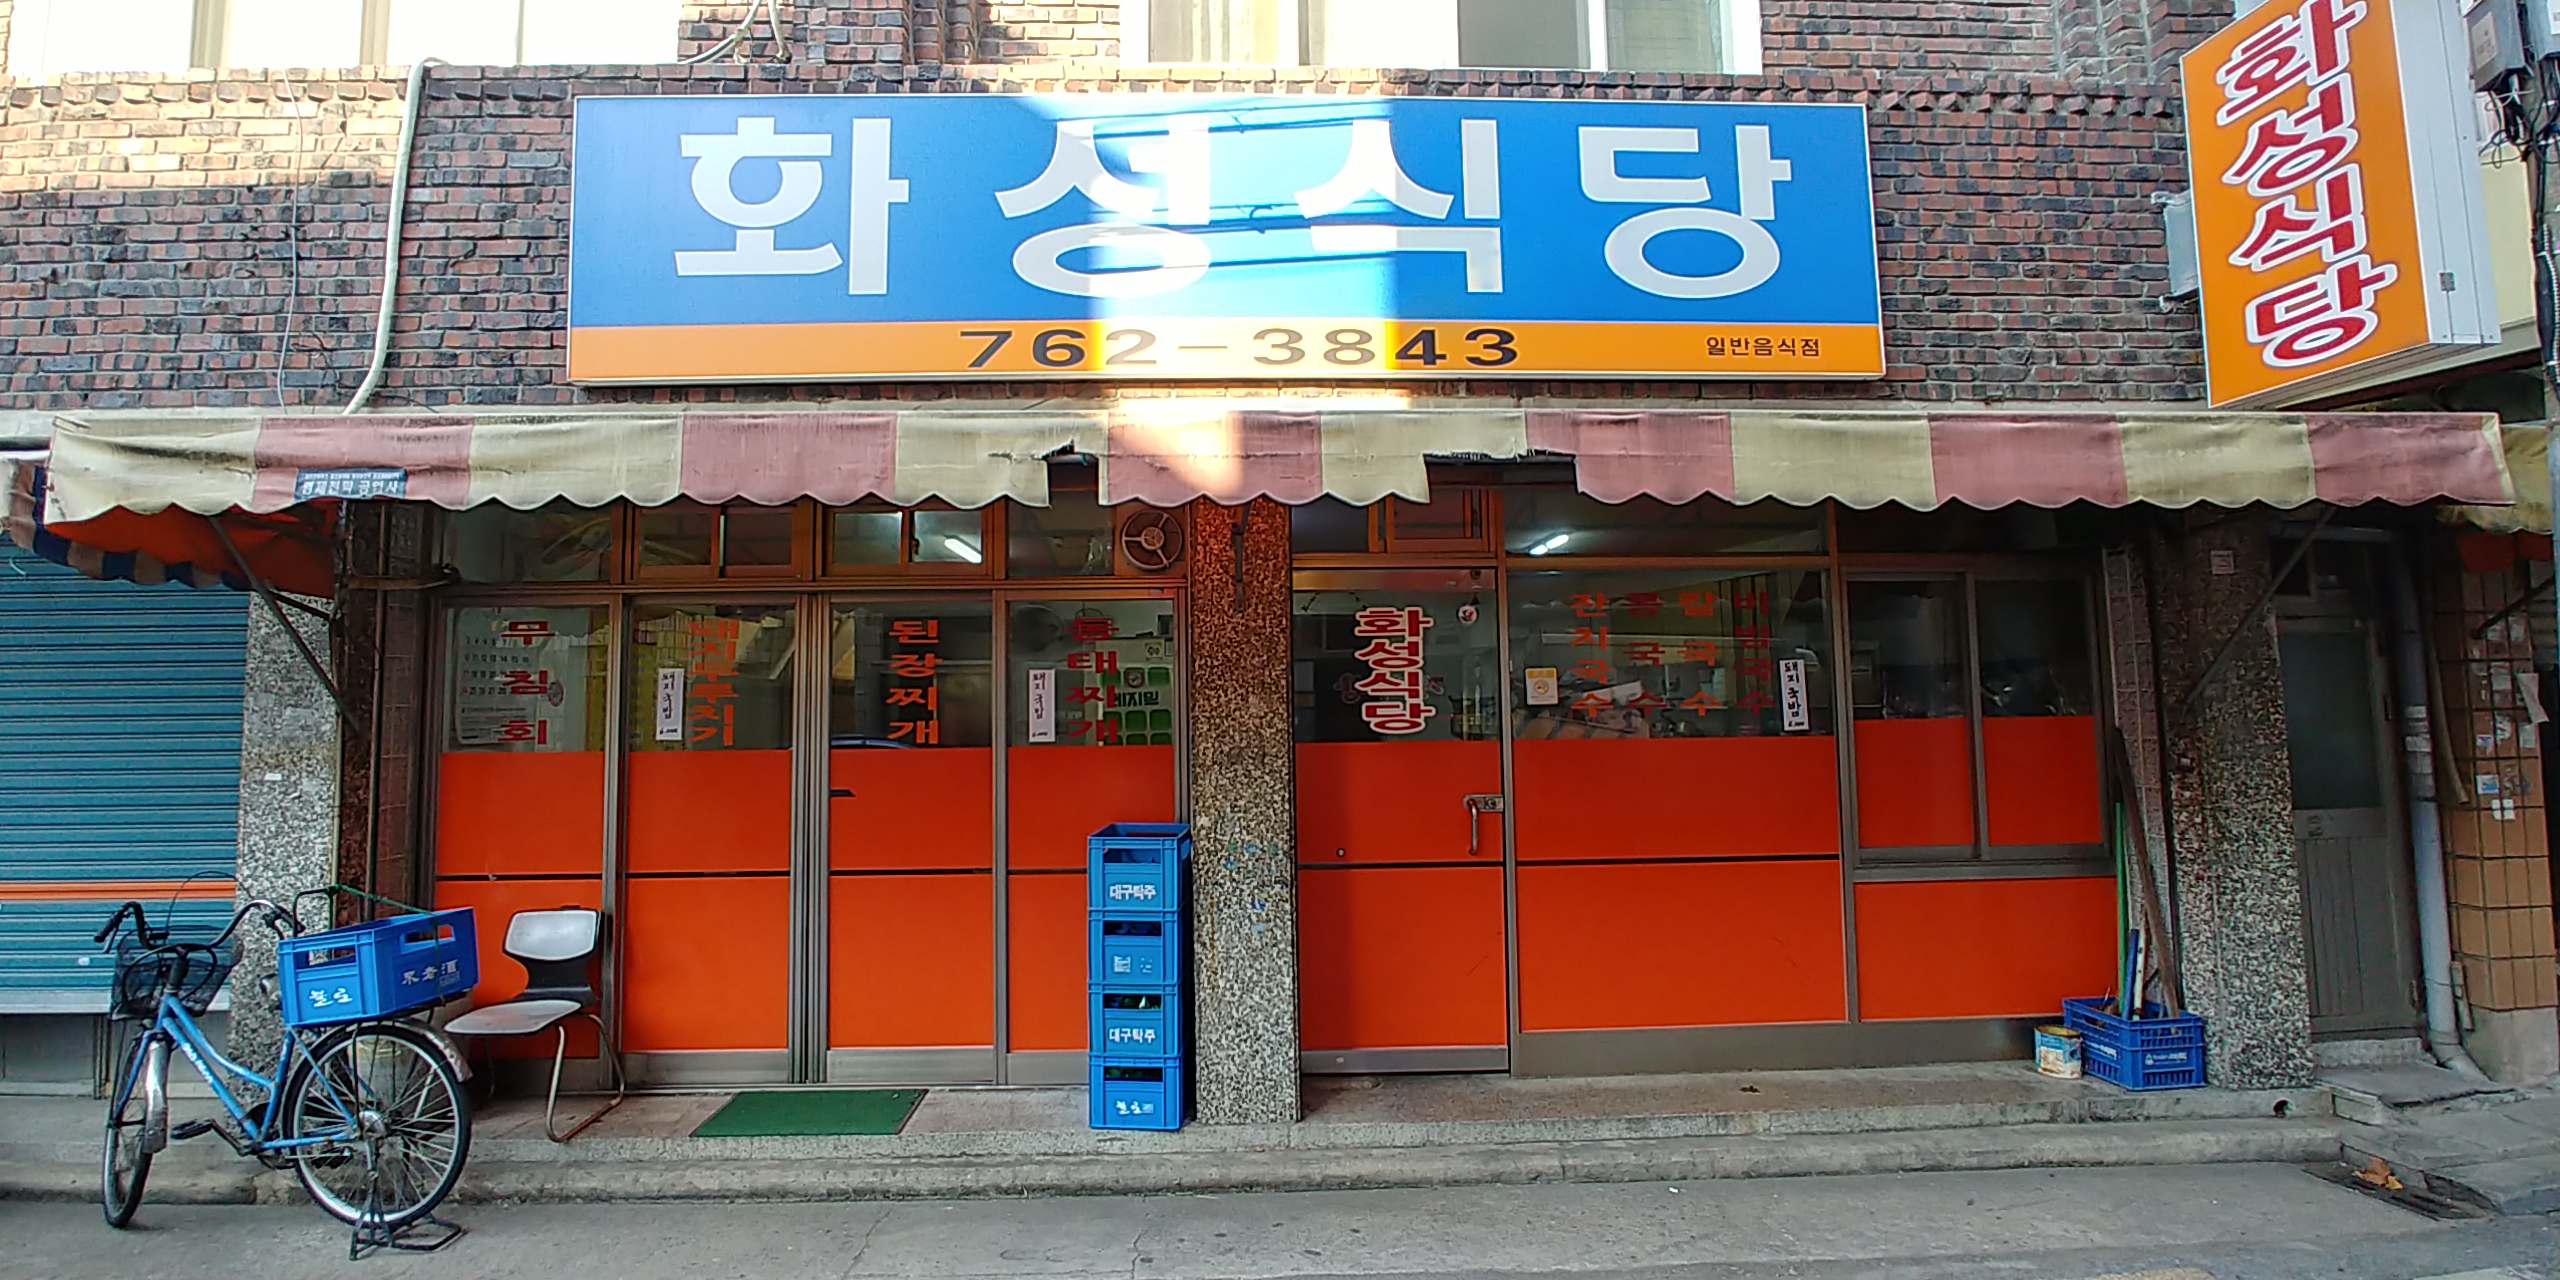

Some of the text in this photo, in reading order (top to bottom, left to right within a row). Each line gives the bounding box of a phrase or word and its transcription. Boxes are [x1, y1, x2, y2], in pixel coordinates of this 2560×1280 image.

[675, 116, 1792, 298] 화성식당
[2217, 0, 2398, 367] 화성식당
[960, 328, 1518, 368] 762-3843
[1706, 336, 1820, 357] 일반음식점
[498, 621, 556, 745] 무침회
[686, 619, 740, 746] 돼지두루치기
[886, 619, 943, 745] 된장찌개
[1033, 672, 1046, 719] 돼지국밥
[1065, 617, 1119, 742] 동태찌개
[1354, 606, 1437, 735] 화성식당
[1569, 592, 1613, 716] 잔치국수
[1621, 592, 1668, 716] 콩국수
[1677, 592, 1722, 716] 칼국수
[1731, 591, 1776, 716] 비빔국수
[1785, 661, 1801, 717] 돼지국밥
[1110, 884, 1157, 900] 대구탁주
[1109, 1028, 1156, 1043] 대구탁주
